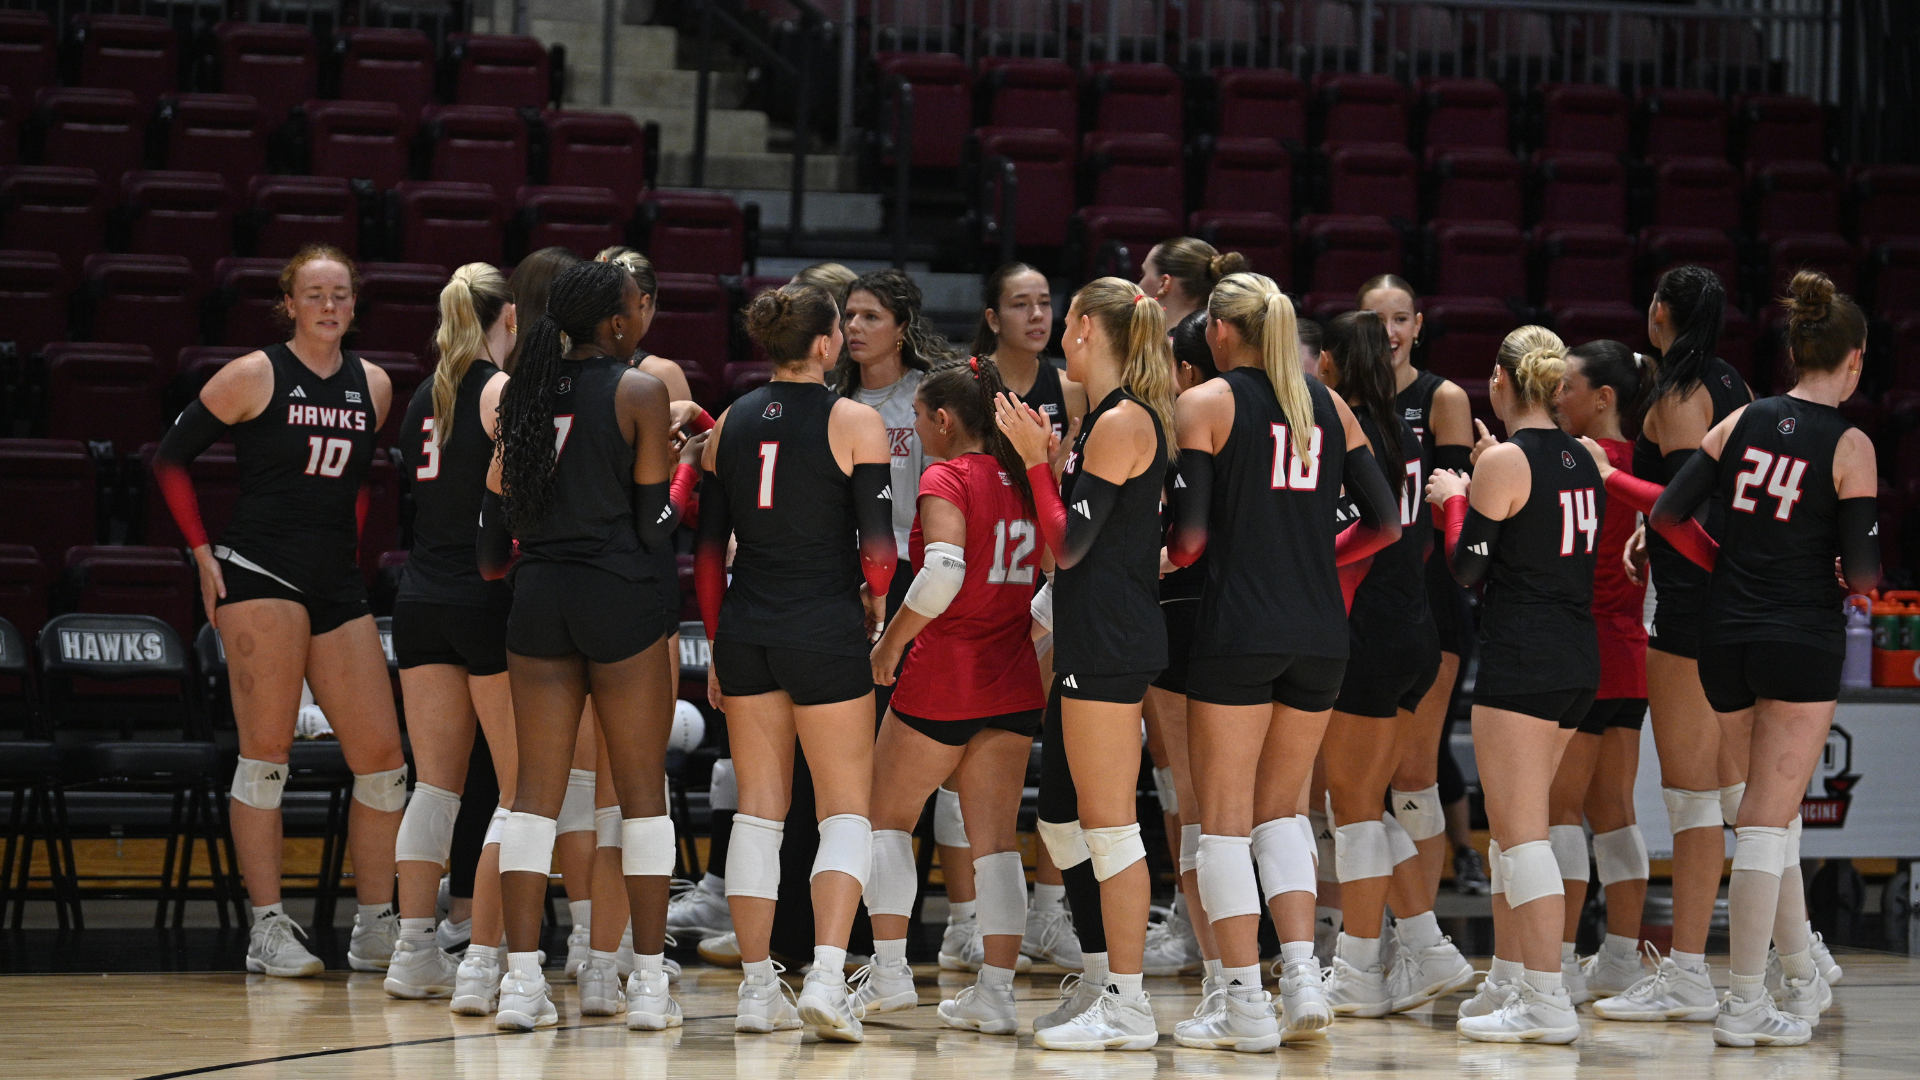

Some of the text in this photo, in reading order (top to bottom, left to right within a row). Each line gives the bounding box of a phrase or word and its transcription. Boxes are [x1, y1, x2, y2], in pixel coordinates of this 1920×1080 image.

[287, 404, 366, 431] HAWKS
[416, 416, 441, 482] 3
[304, 435, 352, 478] 10
[758, 441, 780, 509] 1
[1270, 421, 1324, 491] 18
[1732, 446, 1809, 522] 24
[987, 519, 1036, 585] 12
[1559, 487, 1598, 556] 14
[62, 632, 162, 661] HAWKS
